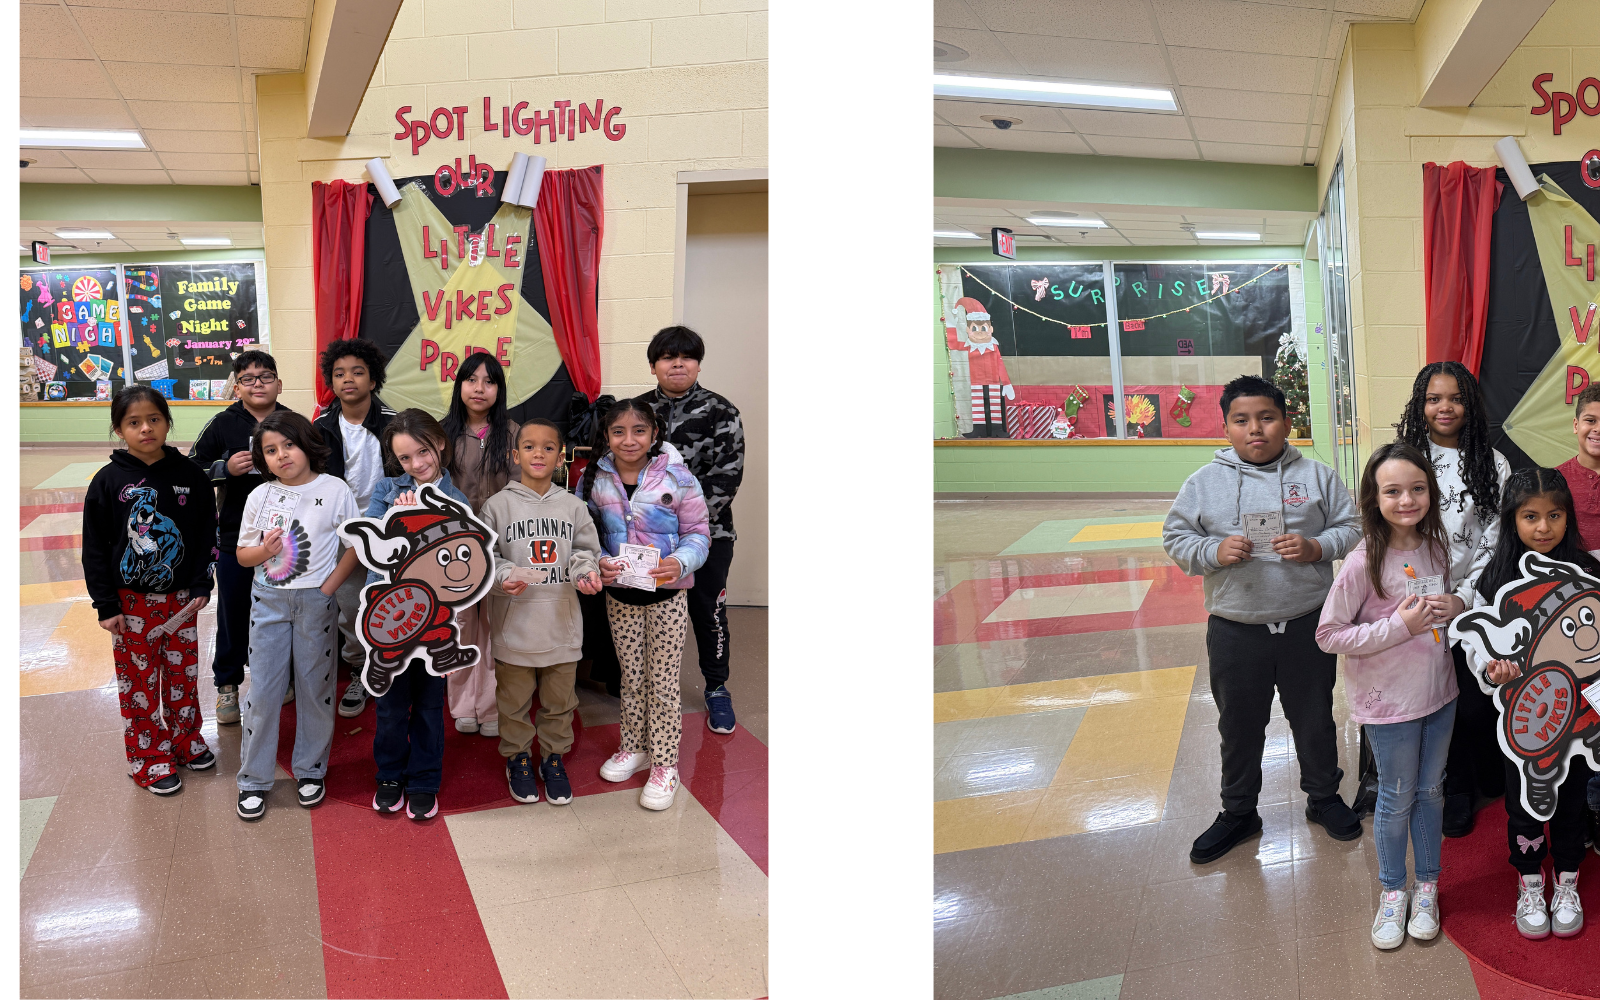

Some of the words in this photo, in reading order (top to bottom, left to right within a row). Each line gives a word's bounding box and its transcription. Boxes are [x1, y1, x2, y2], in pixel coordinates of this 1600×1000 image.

[394, 106, 468, 155] SPOT
[483, 96, 626, 144] LIGHTING
[434, 154, 494, 197] OUR
[422, 223, 521, 269] LITTLE
[1001, 233, 1013, 256] EXIT
[177, 276, 239, 295] Family
[62, 304, 119, 320] GAME
[184, 299, 231, 312] Game
[422, 284, 514, 329] VIKES
[55, 326, 121, 343] NIGH
[180, 318, 229, 335] Night
[184, 339, 232, 350] January
[420, 337, 511, 382] PRE
[172, 485, 190, 495] VENOM
[505, 517, 573, 544] CINCINNAT
[370, 588, 414, 629] LITTLE
[387, 602, 426, 640] VIKES
[1514, 674, 1552, 734] LITTLE
[1534, 687, 1568, 742] VIKES
